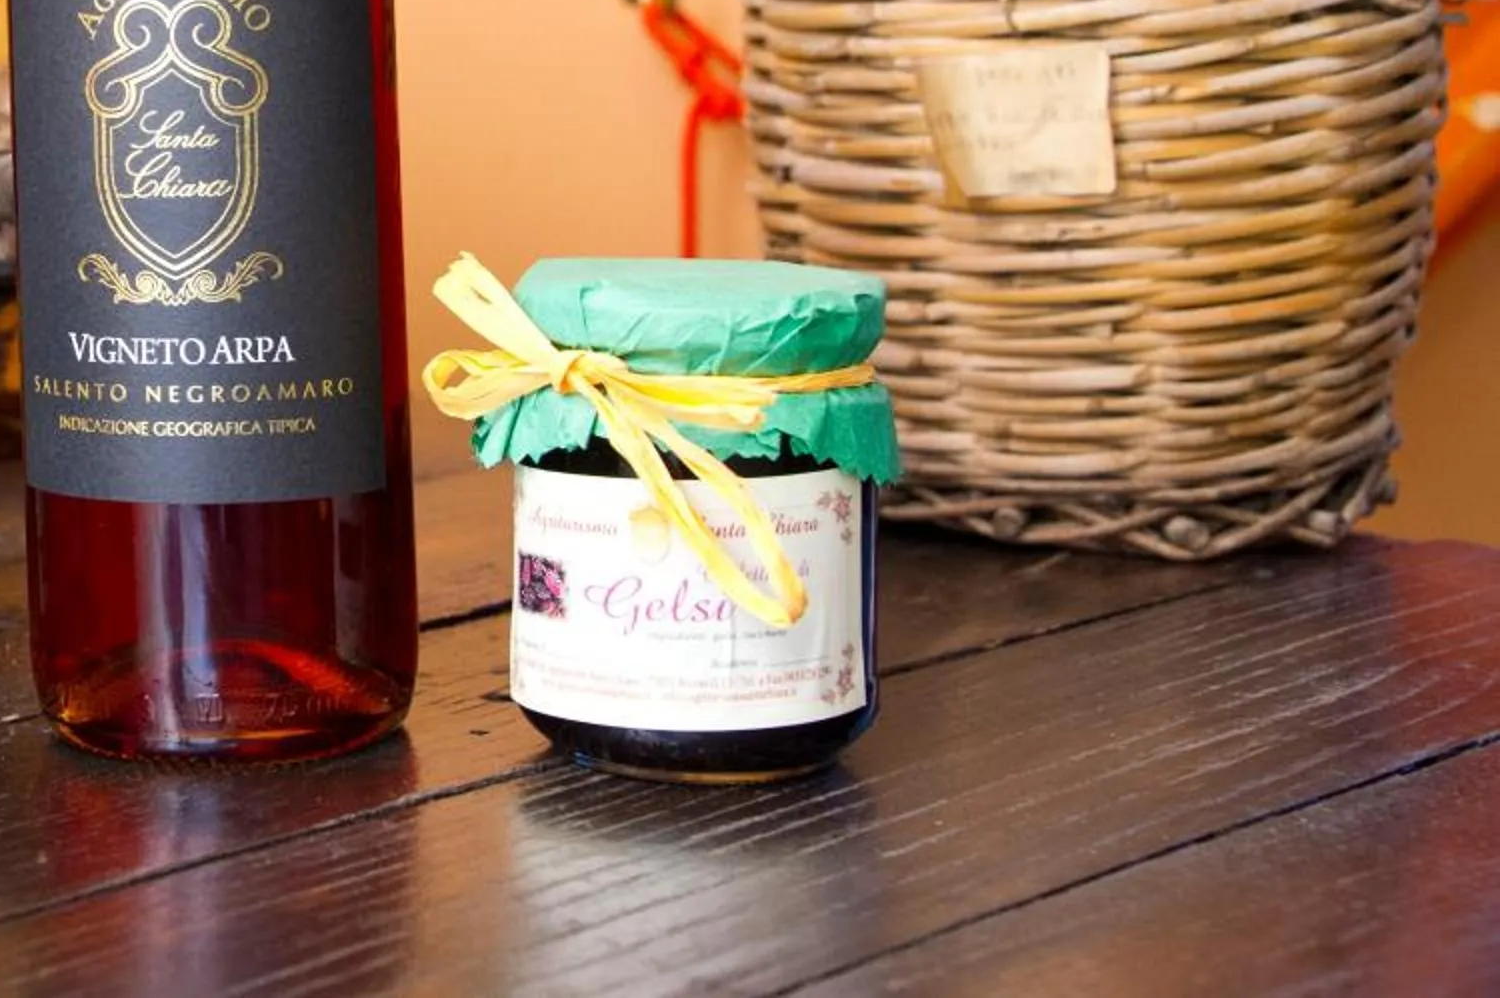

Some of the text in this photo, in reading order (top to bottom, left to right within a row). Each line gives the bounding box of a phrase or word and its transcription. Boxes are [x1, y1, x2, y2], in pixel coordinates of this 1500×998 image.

[130, 109, 220, 151] Santa
[118, 149, 234, 200] Chiara
[68, 331, 296, 366] VIGNETO ARPA
[33, 375, 354, 404] SALENTO NEGROAMARO
[59, 414, 317, 439] INDICAZIONE GEOGRAFICA TIPICA
